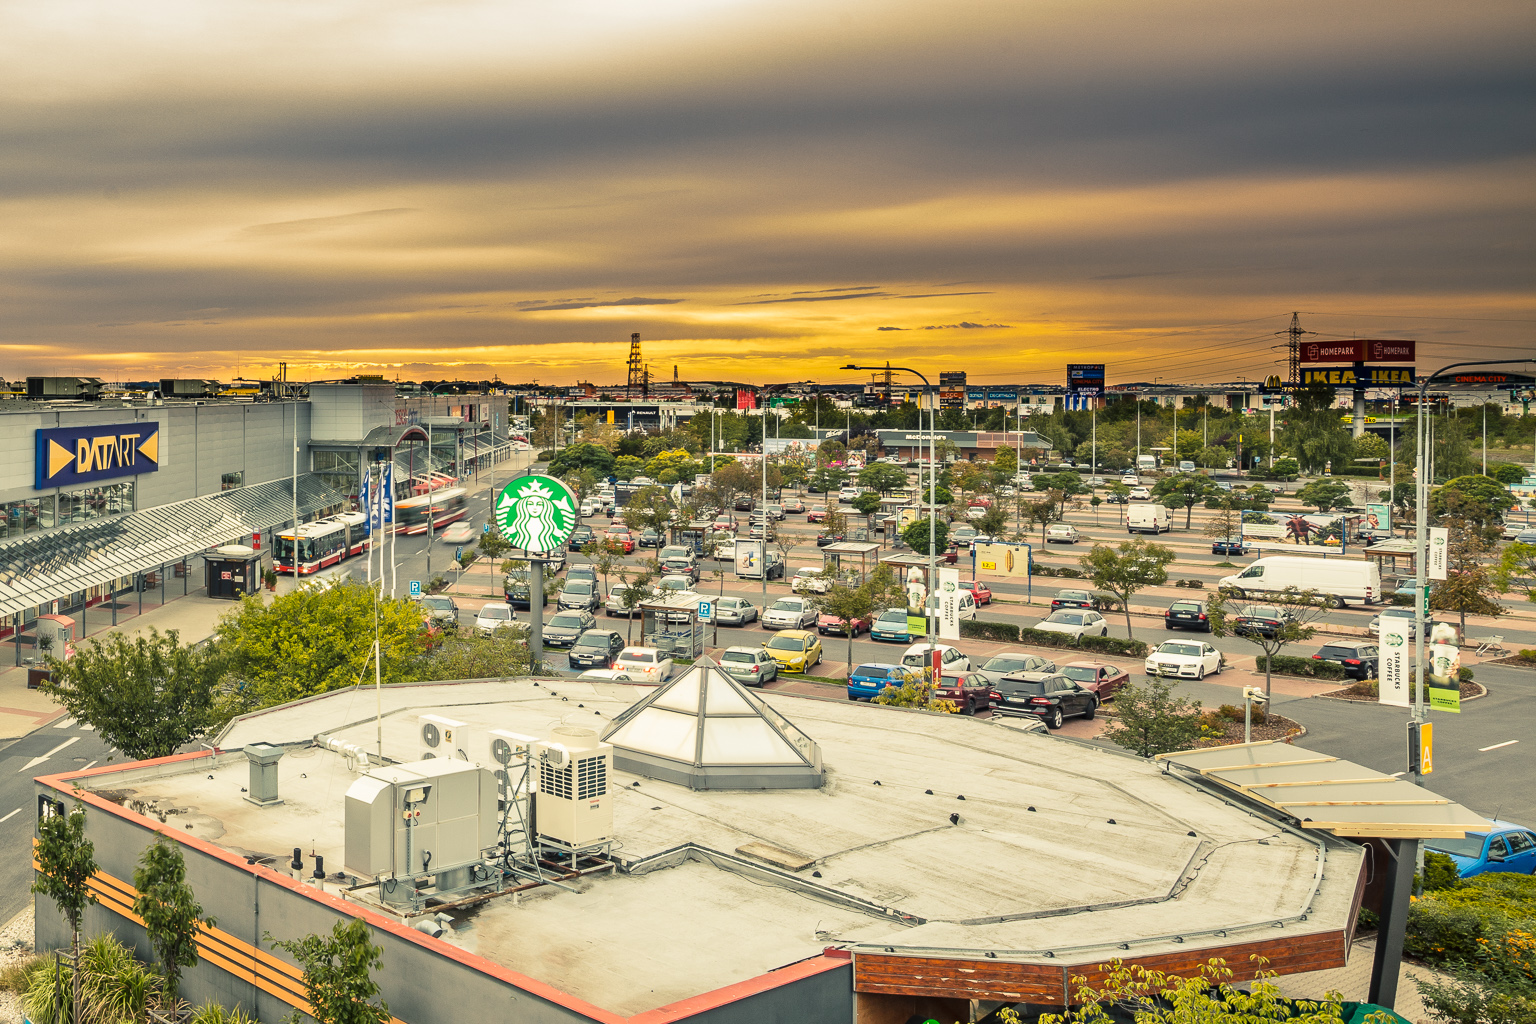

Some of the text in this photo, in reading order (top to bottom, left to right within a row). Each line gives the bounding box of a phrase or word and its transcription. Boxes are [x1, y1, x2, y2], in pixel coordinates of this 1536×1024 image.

[1320, 346, 1354, 356] HOMEPARK
[1383, 346, 1410, 355] HOMEPARK
[1305, 370, 1357, 384] IKEA
[1371, 370, 1411, 384] IKEA
[76, 433, 141, 474] DATART
[700, 603, 709, 613] P
[1424, 597, 1429, 611] 3
[1422, 746, 1432, 769] A
